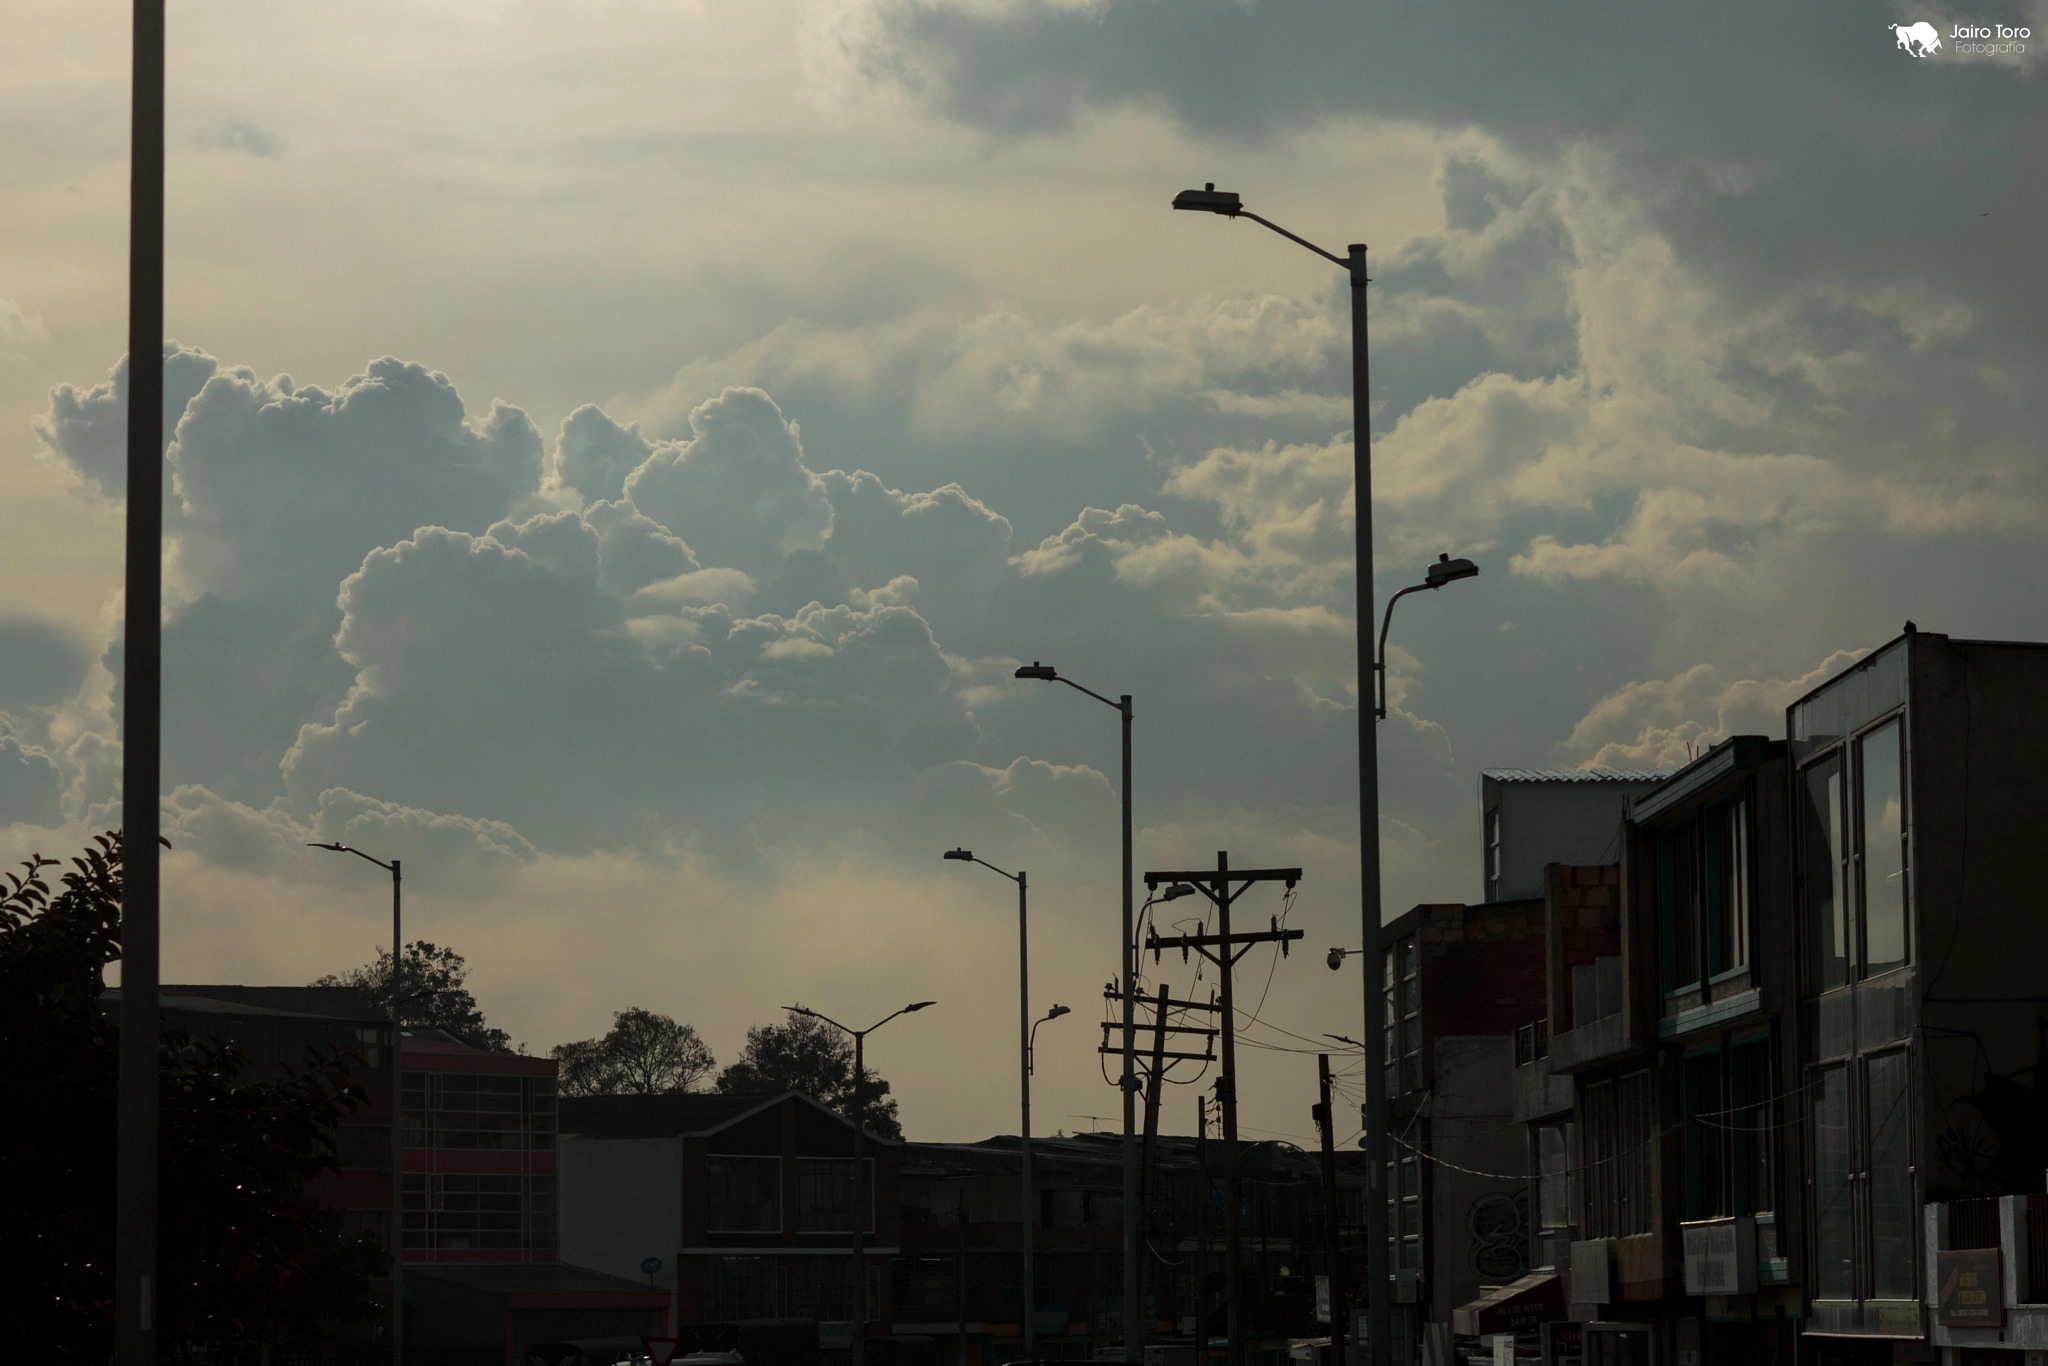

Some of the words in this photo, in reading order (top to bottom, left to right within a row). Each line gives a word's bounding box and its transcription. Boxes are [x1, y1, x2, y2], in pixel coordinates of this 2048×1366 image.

[1496, 1307, 1506, 1316] AV
[1512, 1305, 1522, 1314] DE
[1523, 1302, 1543, 1312] MAYO
[1509, 1317, 1520, 1326] 34
